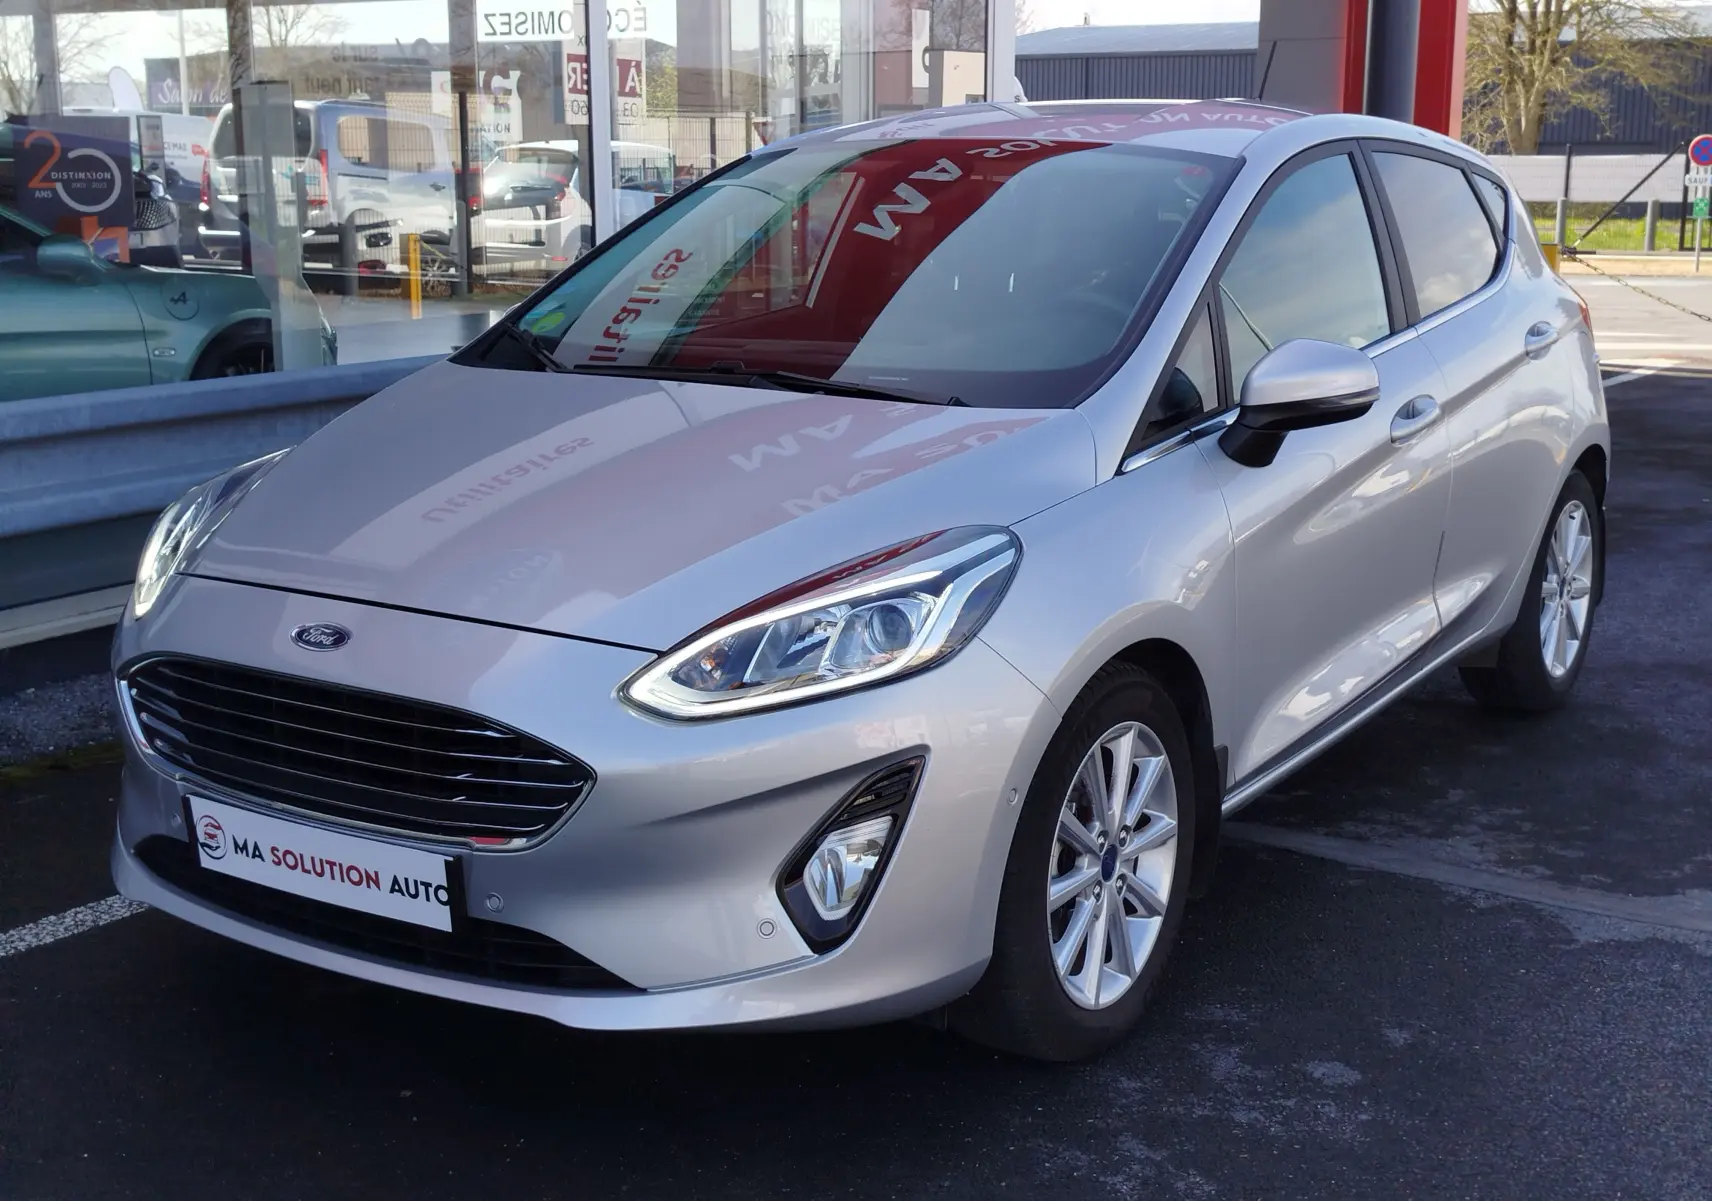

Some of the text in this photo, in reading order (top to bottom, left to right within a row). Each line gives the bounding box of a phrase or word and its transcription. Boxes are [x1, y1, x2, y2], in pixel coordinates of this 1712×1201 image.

[34, 190, 53, 199] ANS
[302, 627, 340, 646] Ford
[232, 834, 451, 906] MA SOLUTION AUTO
